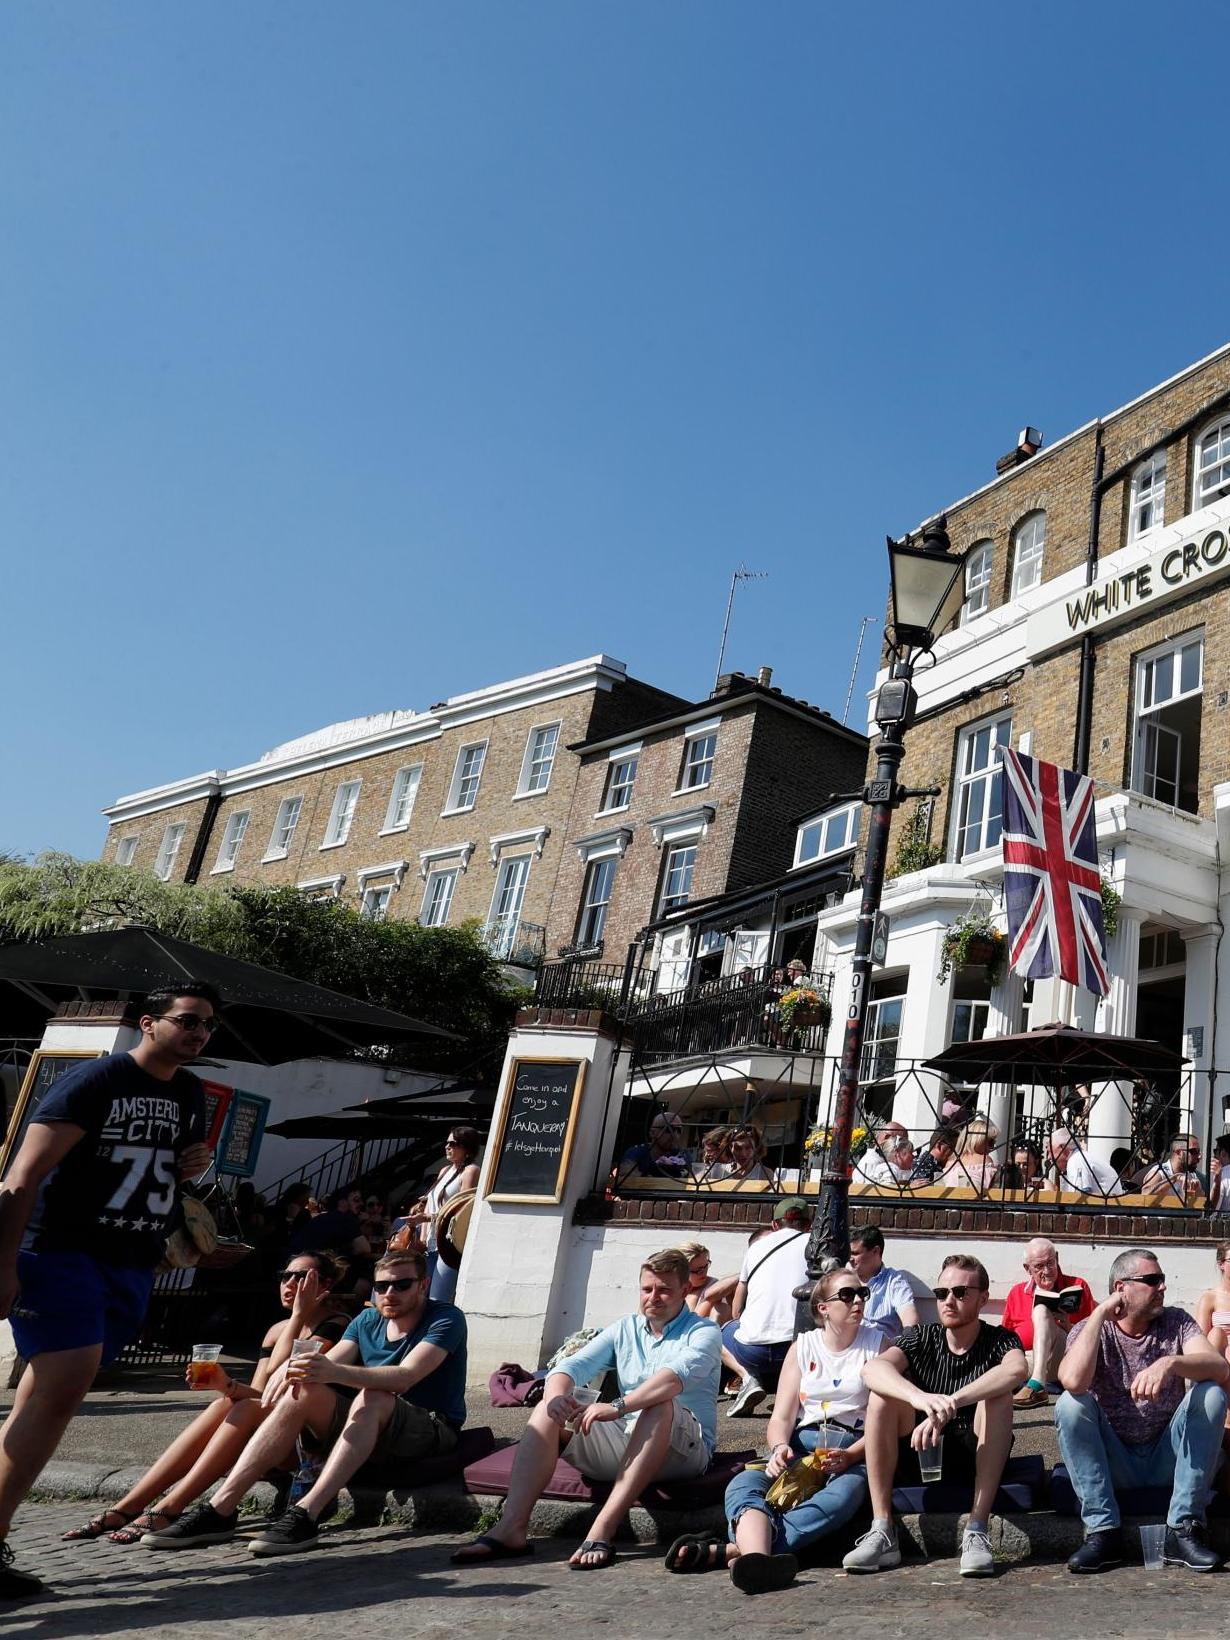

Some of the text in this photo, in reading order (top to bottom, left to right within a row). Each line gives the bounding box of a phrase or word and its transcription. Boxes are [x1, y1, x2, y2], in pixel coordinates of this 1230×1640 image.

[1066, 563, 1153, 630] WHITE
[849, 973, 861, 1019] 010
[516, 1074, 540, 1091] Come
[551, 1084, 568, 1093] and
[104, 1097, 181, 1127] AMSTERD
[522, 1096, 547, 1111] enjoy
[127, 1119, 180, 1144] CITY
[96, 1144, 176, 1215] 12 75
